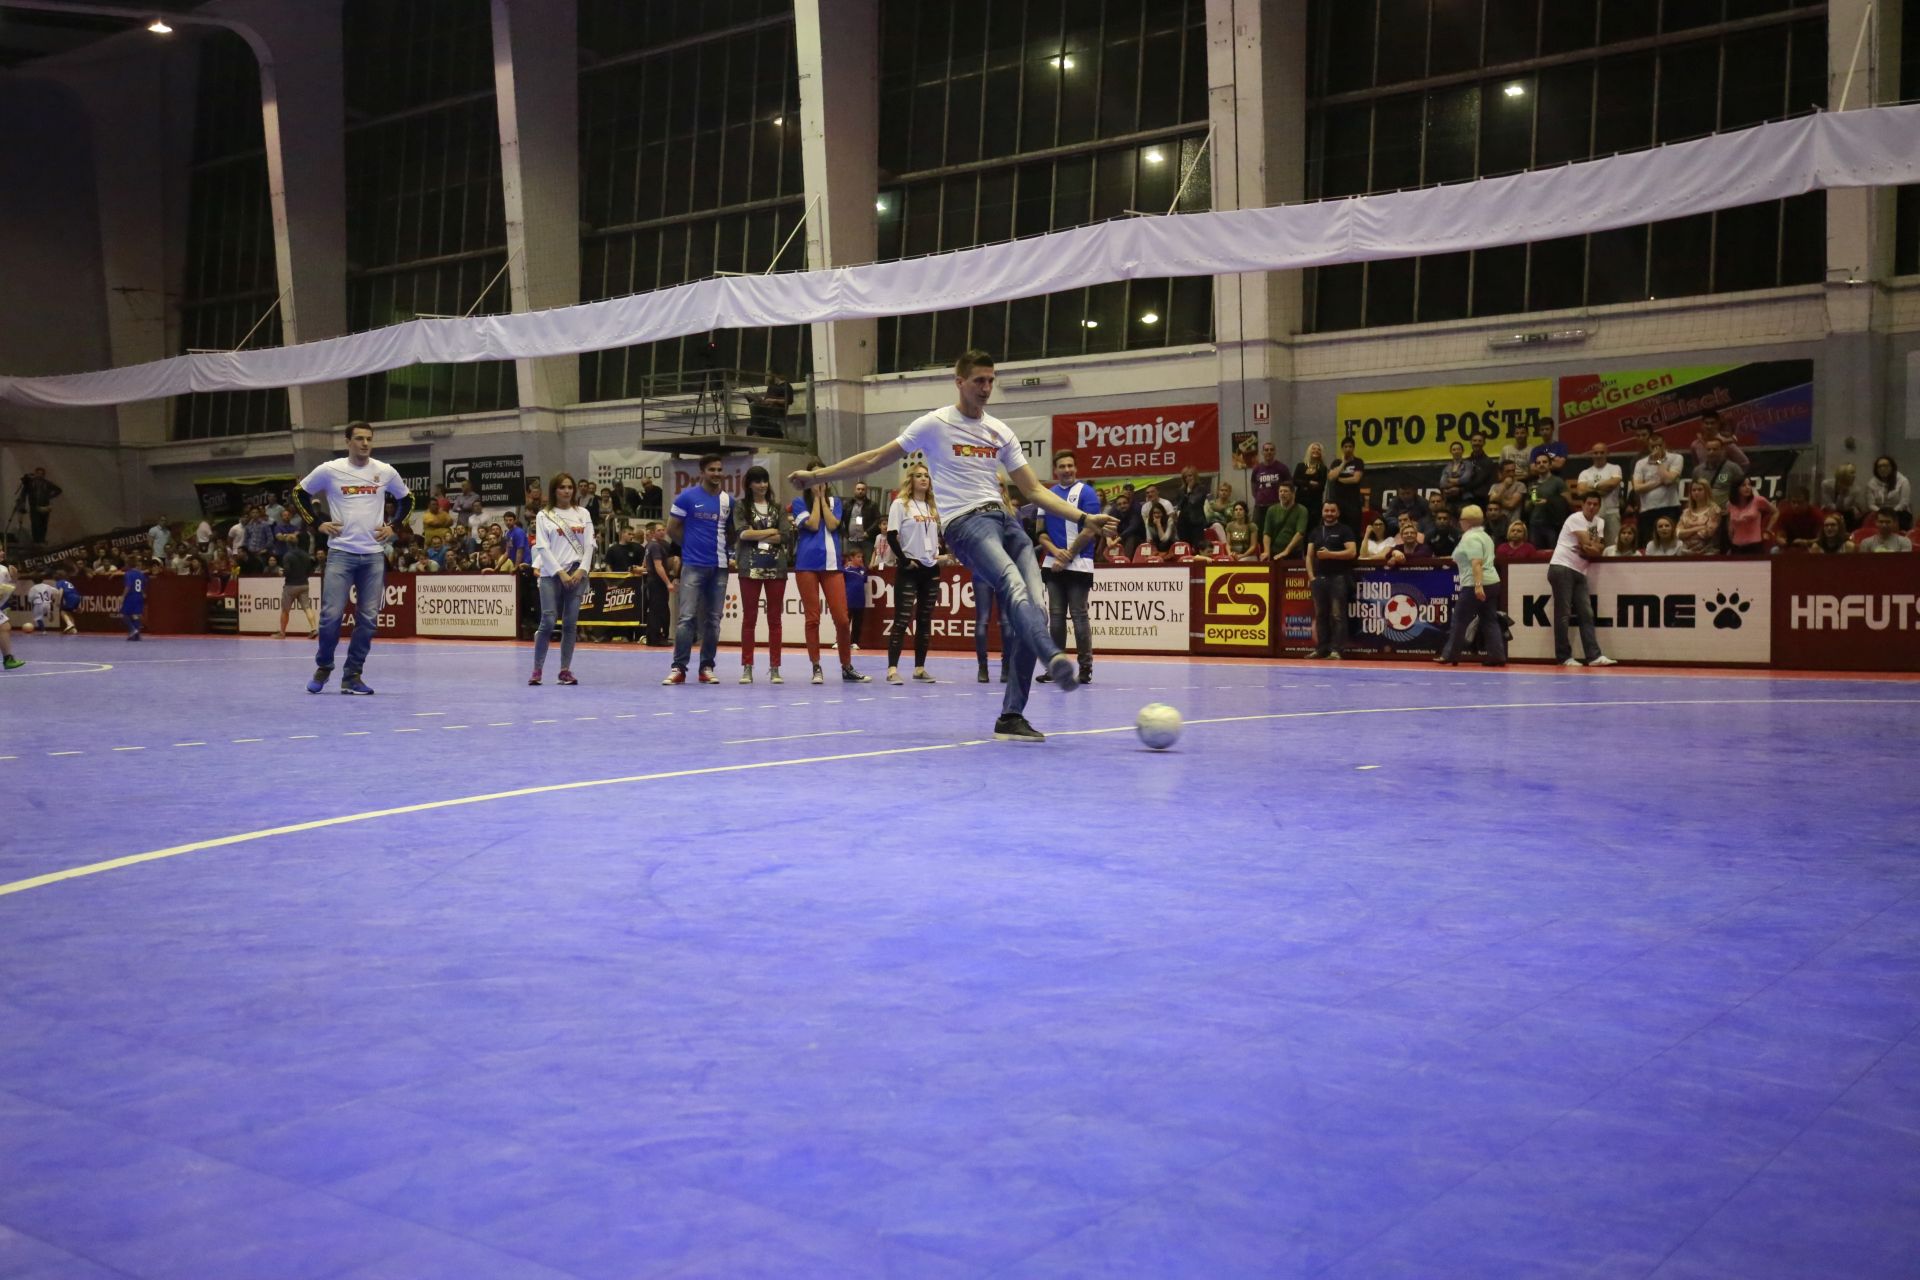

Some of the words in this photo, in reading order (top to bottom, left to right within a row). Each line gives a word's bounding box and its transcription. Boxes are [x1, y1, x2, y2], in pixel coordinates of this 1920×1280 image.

[1344, 414, 1425, 447] FOTO
[1436, 400, 1541, 443] POŠTA
[1076, 416, 1195, 450] Premjer
[1091, 451, 1176, 469] ZAGREB
[134, 579, 141, 592] 8
[417, 584, 422, 593] U
[422, 584, 447, 593] SVAKOM
[447, 584, 490, 593] NOGOMETNOM
[491, 584, 513, 593] KUTKU
[1092, 581, 1144, 592] OMETNOM
[1146, 581, 1184, 592] KUTKU
[1356, 581, 1392, 600] FUSIO
[1522, 594, 1696, 628] KLME
[1108, 626, 1158, 636] REZULTATI
[1207, 628, 1266, 642] express
